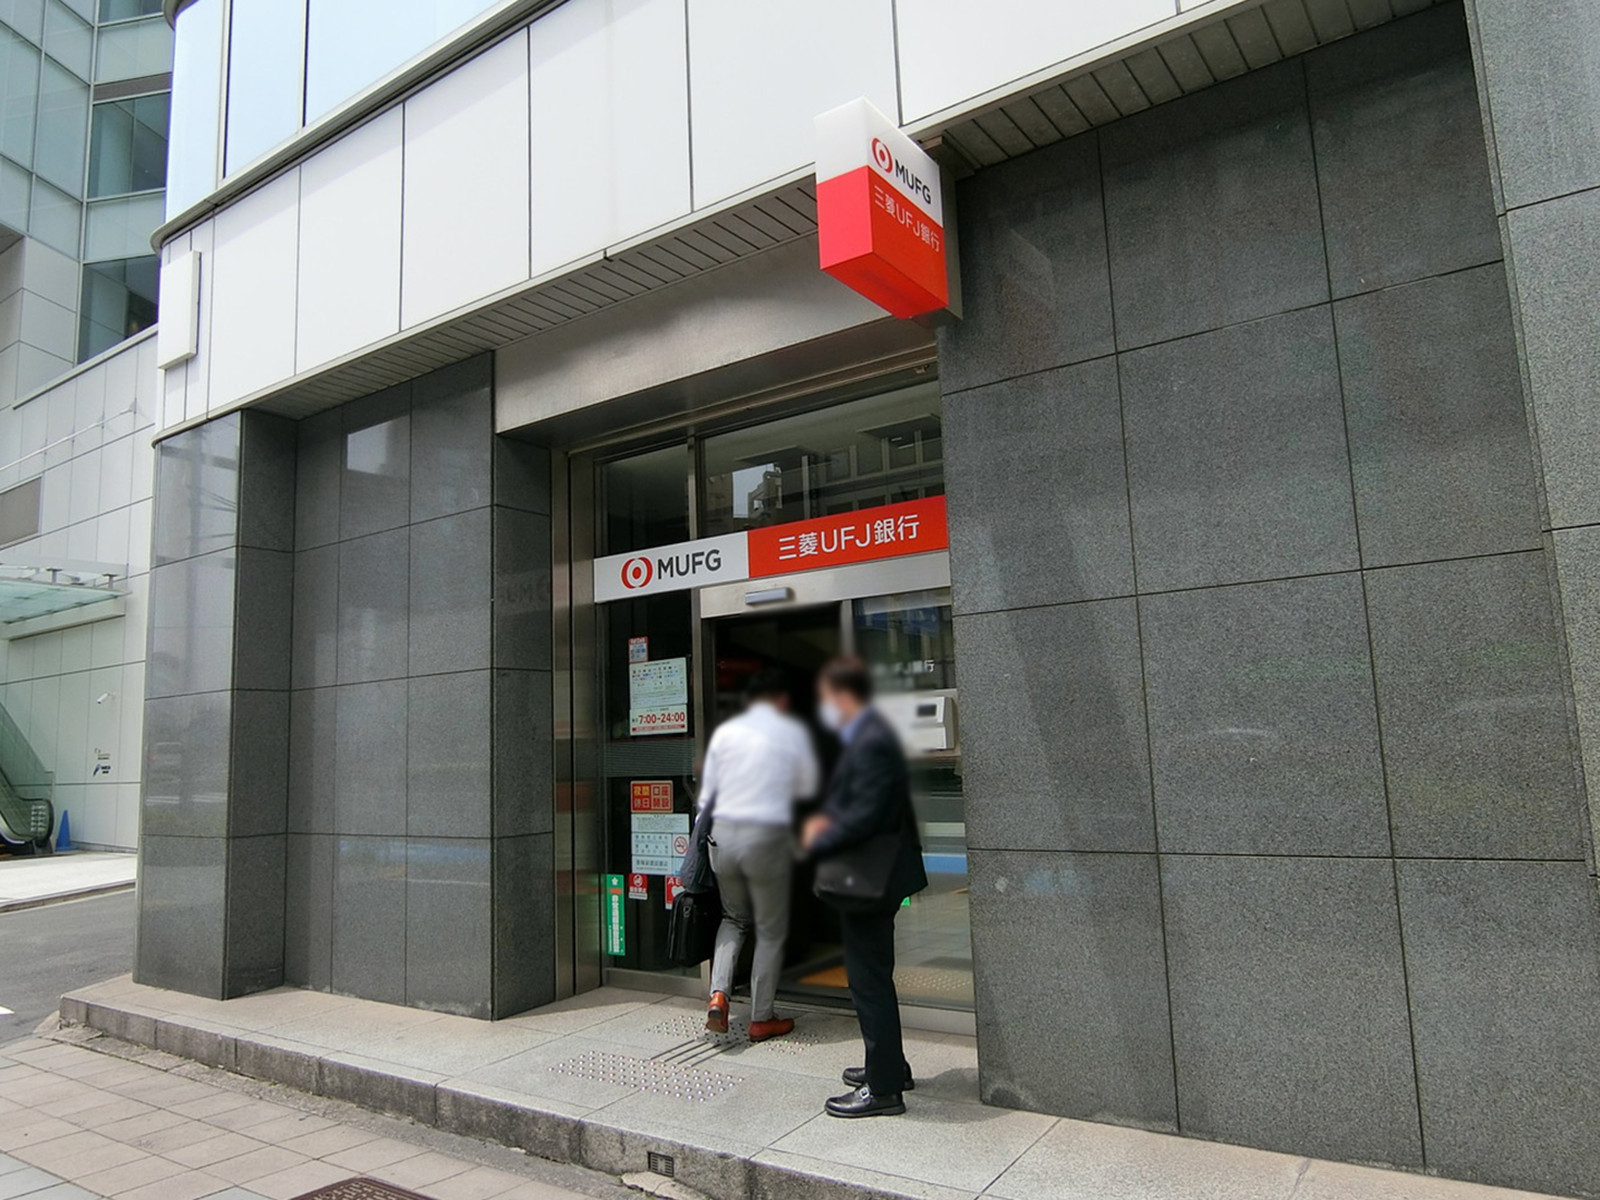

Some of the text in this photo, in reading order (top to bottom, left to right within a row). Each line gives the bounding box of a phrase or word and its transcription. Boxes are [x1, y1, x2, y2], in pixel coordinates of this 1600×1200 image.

[895, 159, 931, 204] MUFG
[874, 184, 940, 252] 三菱UFJ銀行
[779, 514, 920, 560] 三菱UFJ銀行
[658, 549, 721, 580] MUFG
[667, 877, 683, 886] AE
